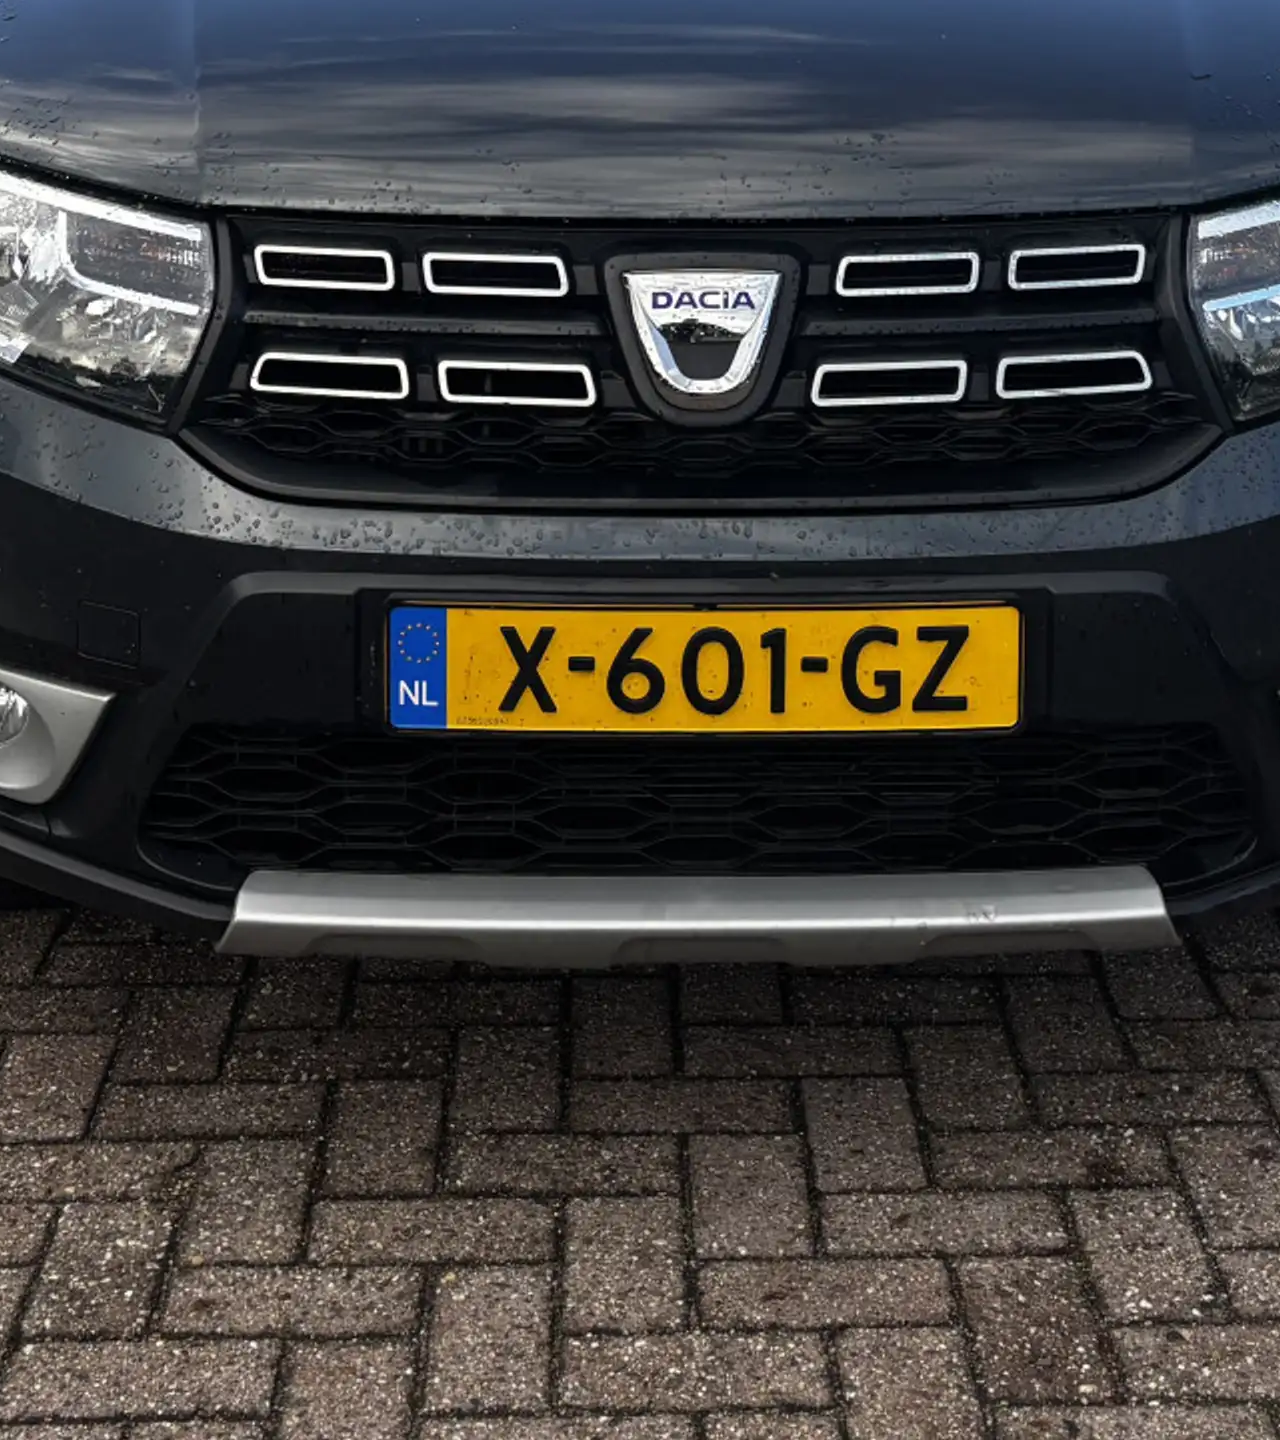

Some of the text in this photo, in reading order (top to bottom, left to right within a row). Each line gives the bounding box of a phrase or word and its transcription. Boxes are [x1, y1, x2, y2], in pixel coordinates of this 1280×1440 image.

[651, 291, 756, 310] DACIA
[498, 625, 970, 715] X-601-GZ
[398, 679, 440, 706] NL
